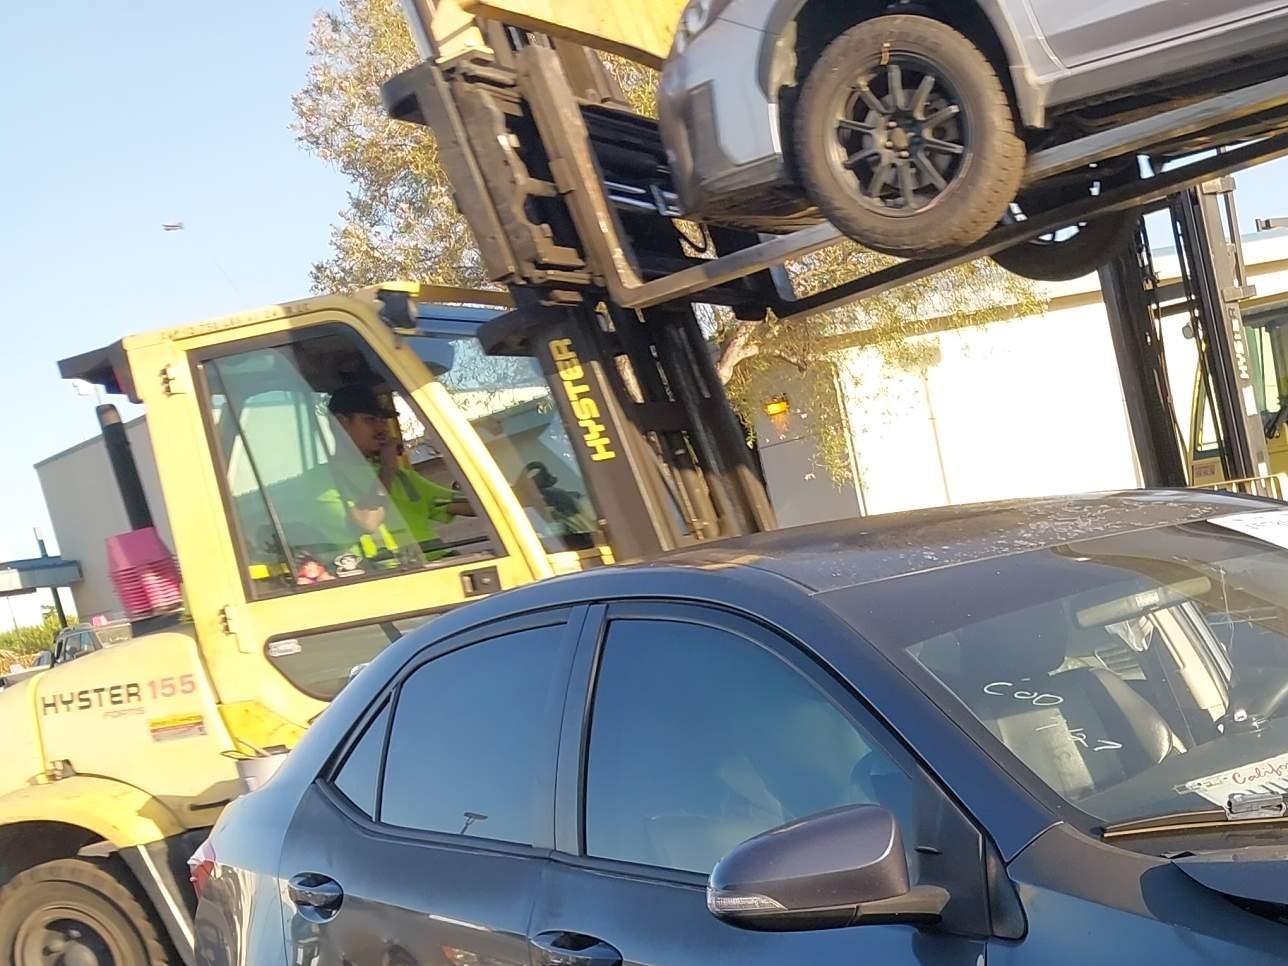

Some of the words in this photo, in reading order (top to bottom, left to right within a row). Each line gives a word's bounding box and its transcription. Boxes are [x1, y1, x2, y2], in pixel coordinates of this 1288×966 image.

[549, 338, 616, 461] HYSTER
[41, 682, 142, 716] HYSTER
[148, 673, 196, 700] 155
